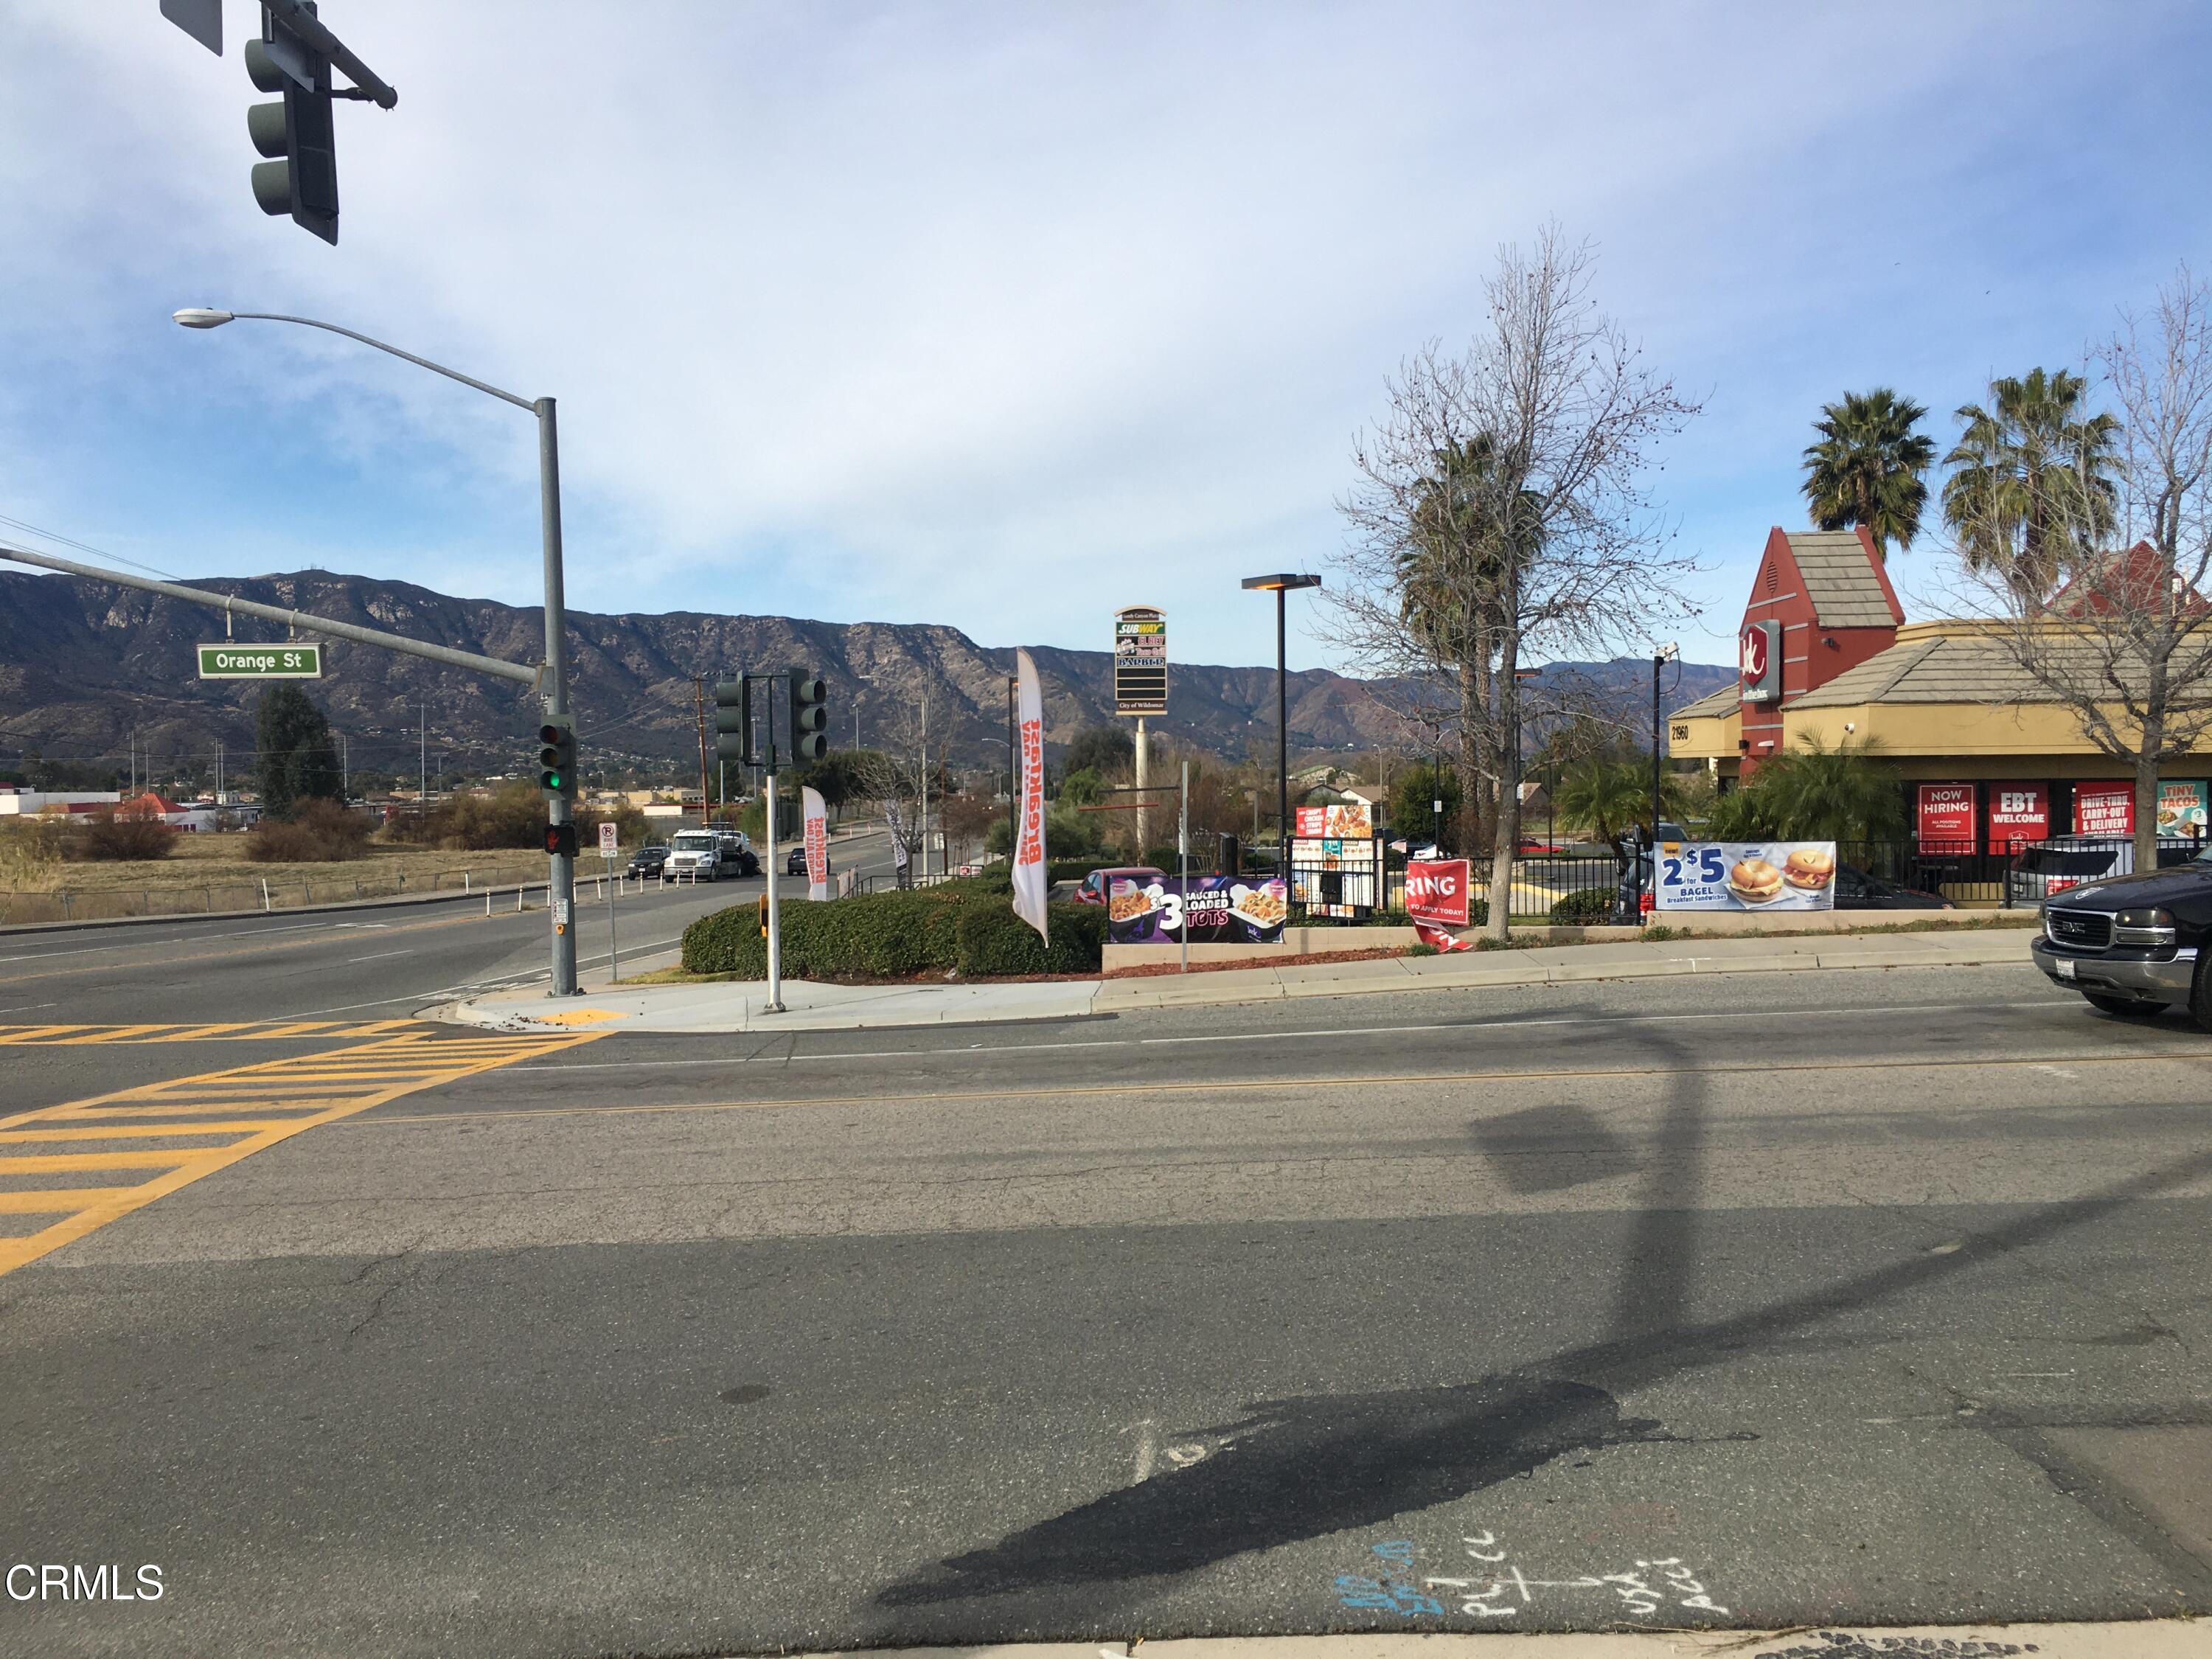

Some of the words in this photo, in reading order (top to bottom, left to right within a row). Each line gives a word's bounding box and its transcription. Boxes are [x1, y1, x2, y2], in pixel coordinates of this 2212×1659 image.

[1119, 625, 1163, 633] SUBWAY
[216, 653, 276, 672] Orange
[283, 653, 302, 667] St
[1119, 658, 1164, 667] BARBER
[1672, 725, 1688, 740] 21960
[1931, 790, 1962, 801] NOW
[1924, 802, 1969, 814] HIRING
[2001, 793, 2037, 813] EBT
[2081, 796, 2129, 808] DRIVE-THRU,
[2160, 796, 2199, 809] TACOS
[1993, 814, 2045, 823] WELCOME
[2082, 807, 2126, 820] CARRY-OUT
[2083, 821, 2089, 831] &
[2090, 818, 2128, 830] DELIVERY
[1663, 858, 1682, 886] 2
[1186, 891, 1220, 900] SAUCED
[1220, 890, 1228, 898] &
[1680, 887, 1714, 897] BAGEL
[1186, 899, 1228, 910] LOADED
[1150, 894, 1183, 930] $3
[1439, 908, 1464, 916] TODAY!
